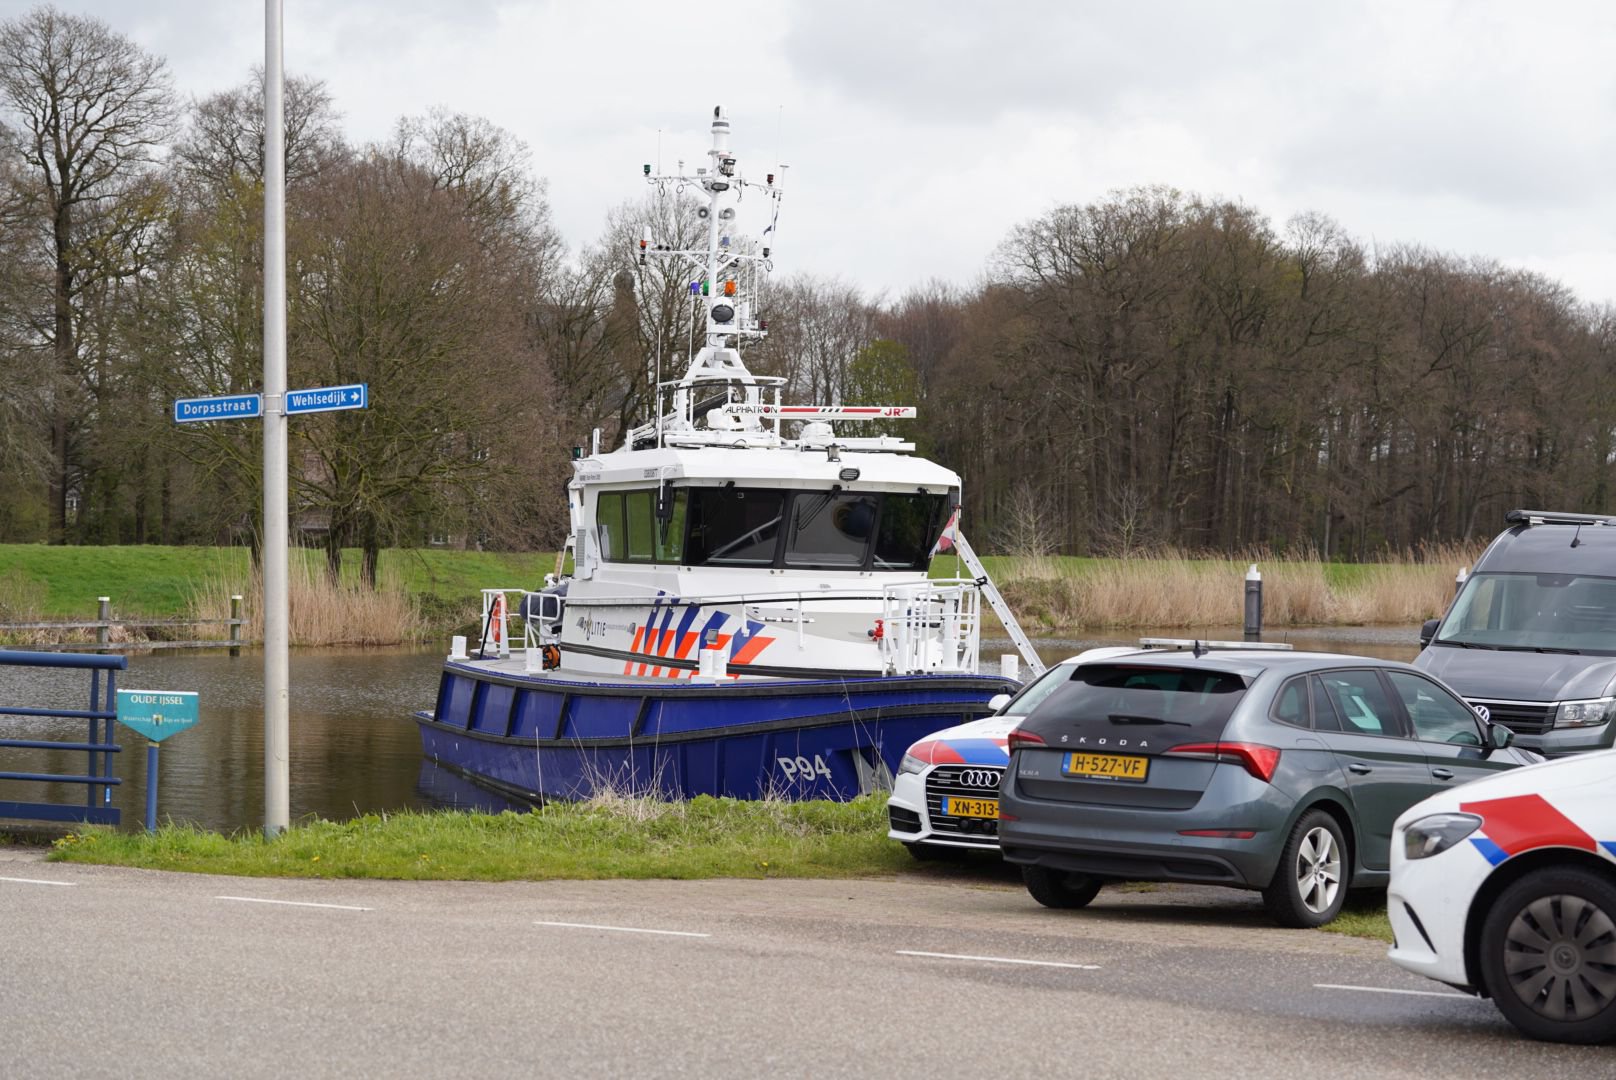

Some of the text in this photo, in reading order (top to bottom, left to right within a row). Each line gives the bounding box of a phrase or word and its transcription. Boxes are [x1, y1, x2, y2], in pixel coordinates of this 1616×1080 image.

[292, 390, 347, 407] Wehlsedijk
[183, 399, 252, 416] Dorpsstraat
[725, 405, 778, 415] ALPHATRON
[130, 694, 184, 706] OUDE IJSSEL
[776, 754, 833, 783] P94
[1075, 755, 1141, 775] H-527-VF
[953, 800, 999, 816] XN-313-
